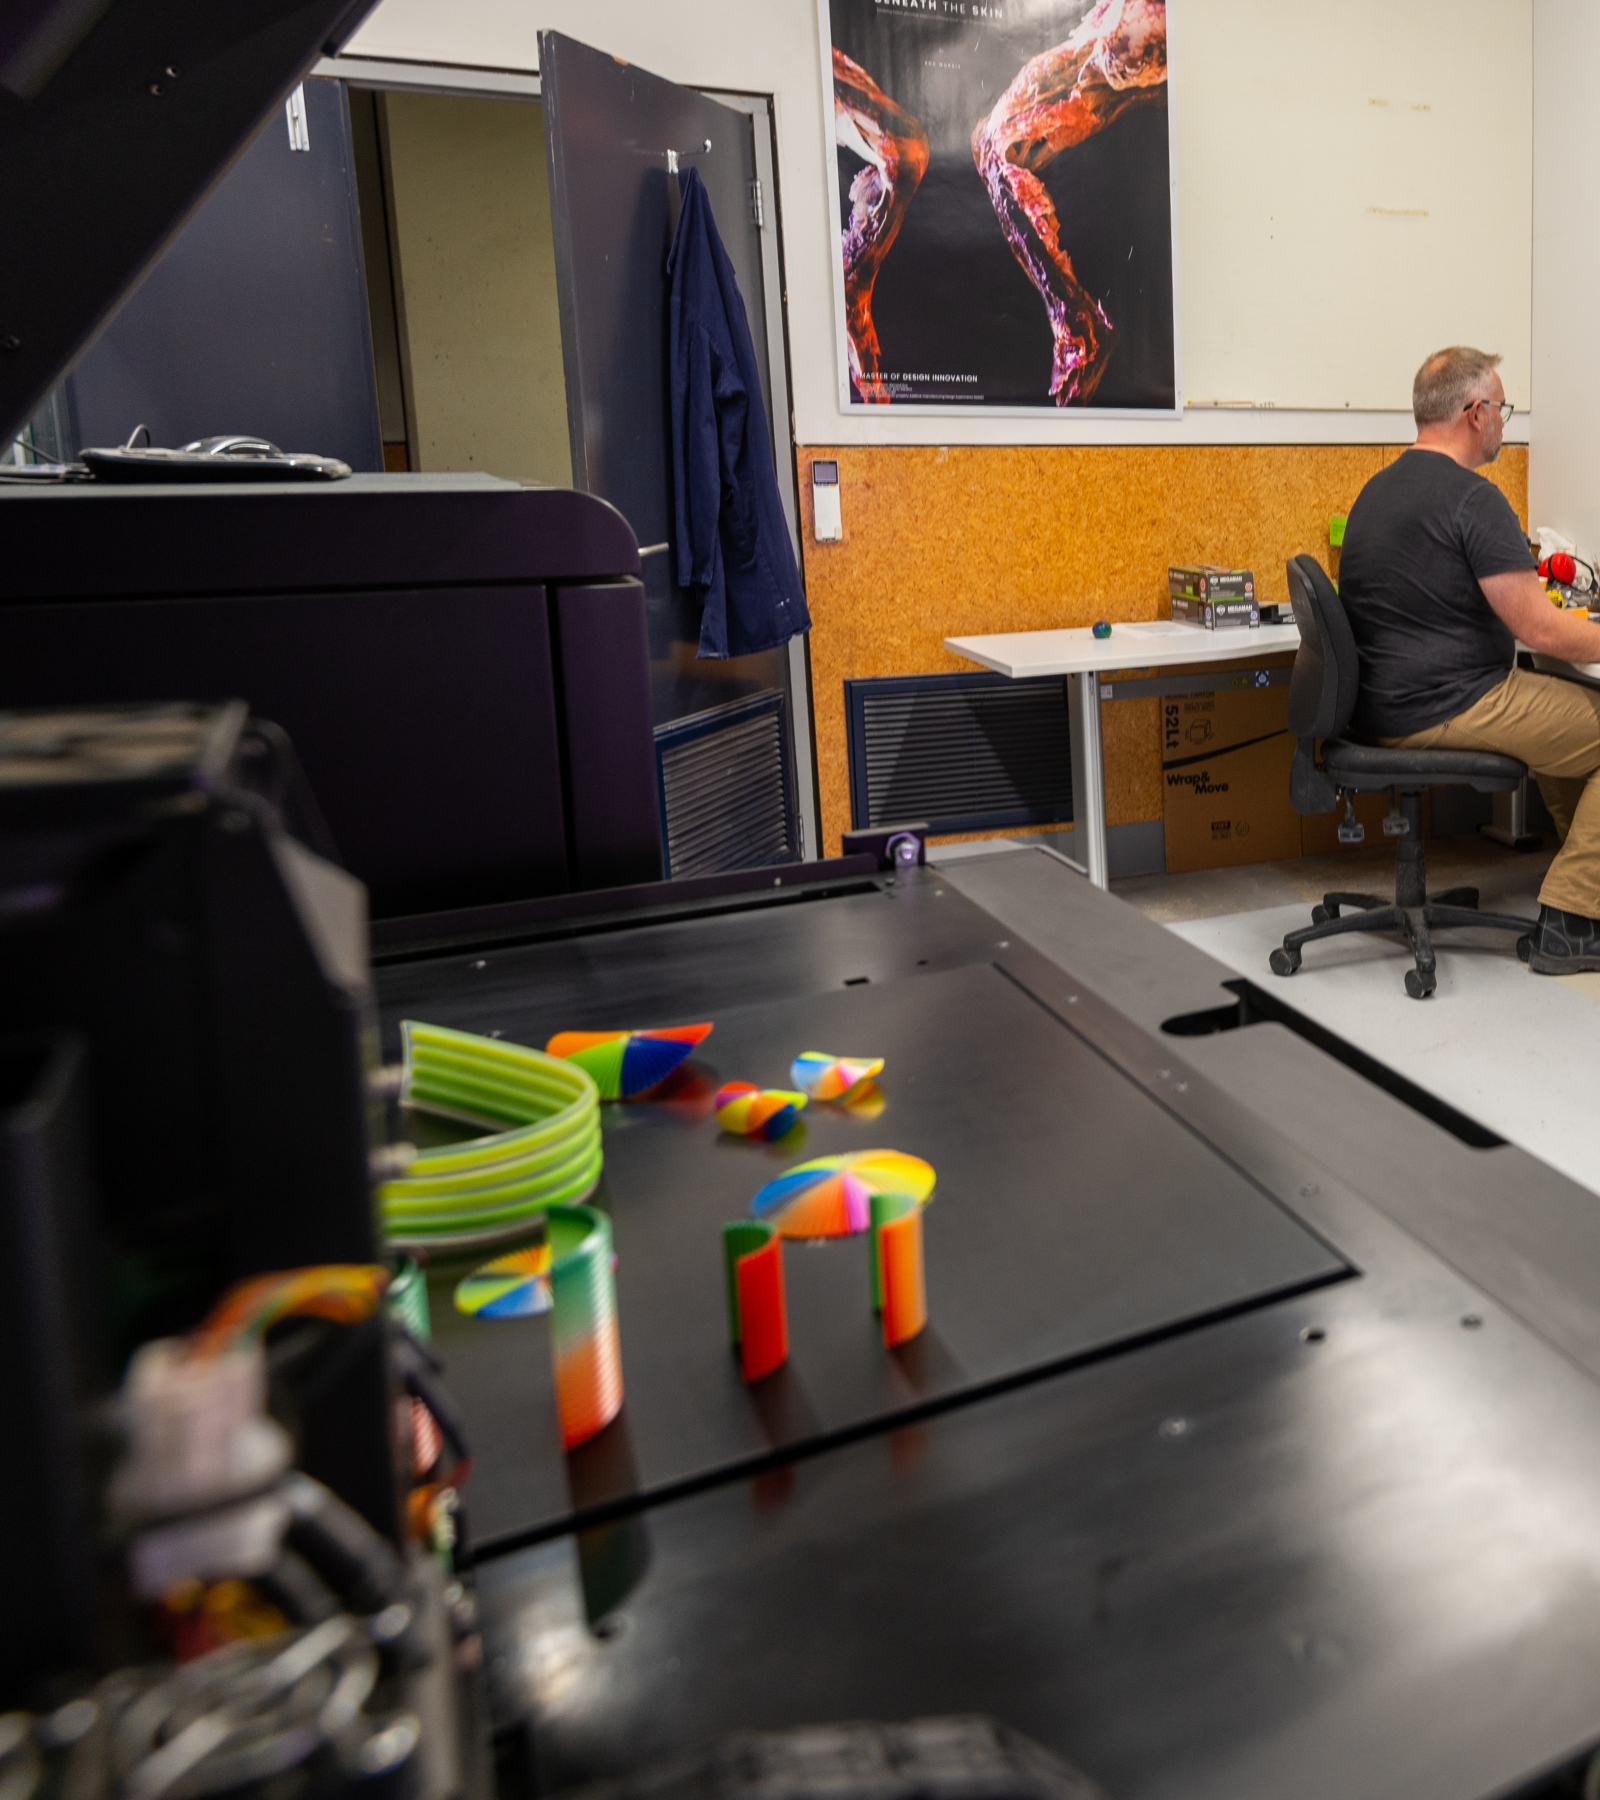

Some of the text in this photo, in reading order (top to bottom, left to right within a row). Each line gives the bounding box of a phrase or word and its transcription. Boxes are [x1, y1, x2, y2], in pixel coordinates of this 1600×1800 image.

[943, 3, 966, 15] THE
[972, 6, 1003, 19] SKIN
[861, 371, 978, 383] MASTER OF DESIGN INNOVATION
[1165, 704, 1180, 749] 52Lt
[1166, 771, 1211, 787] Wrap&
[1195, 782, 1230, 795] Move
